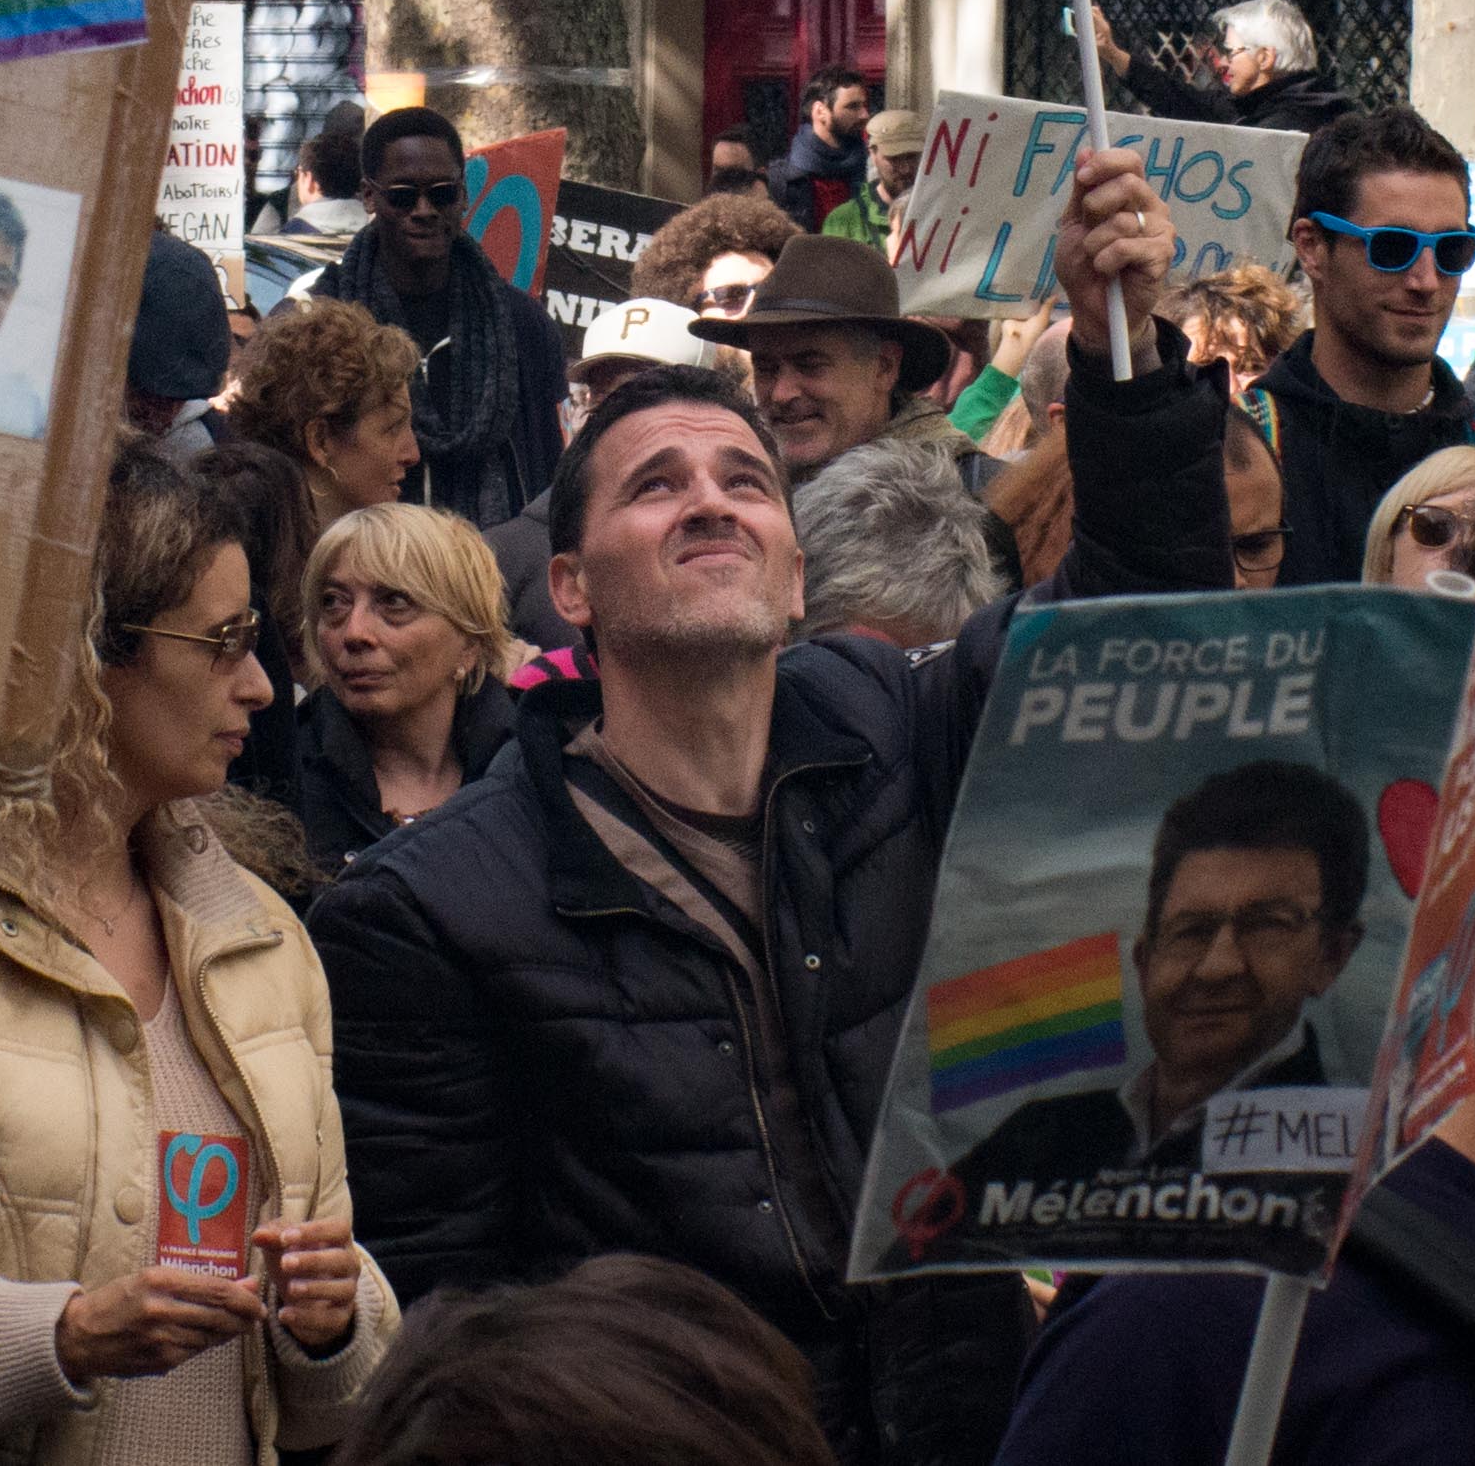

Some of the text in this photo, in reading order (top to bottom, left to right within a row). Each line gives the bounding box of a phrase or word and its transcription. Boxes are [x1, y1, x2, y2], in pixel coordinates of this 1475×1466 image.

[620, 307, 650, 340] P
[1028, 629, 1325, 680] LA FORCE DU
[1009, 672, 1317, 746] PEUPLE
[978, 1172, 1300, 1228] Mélenchon
